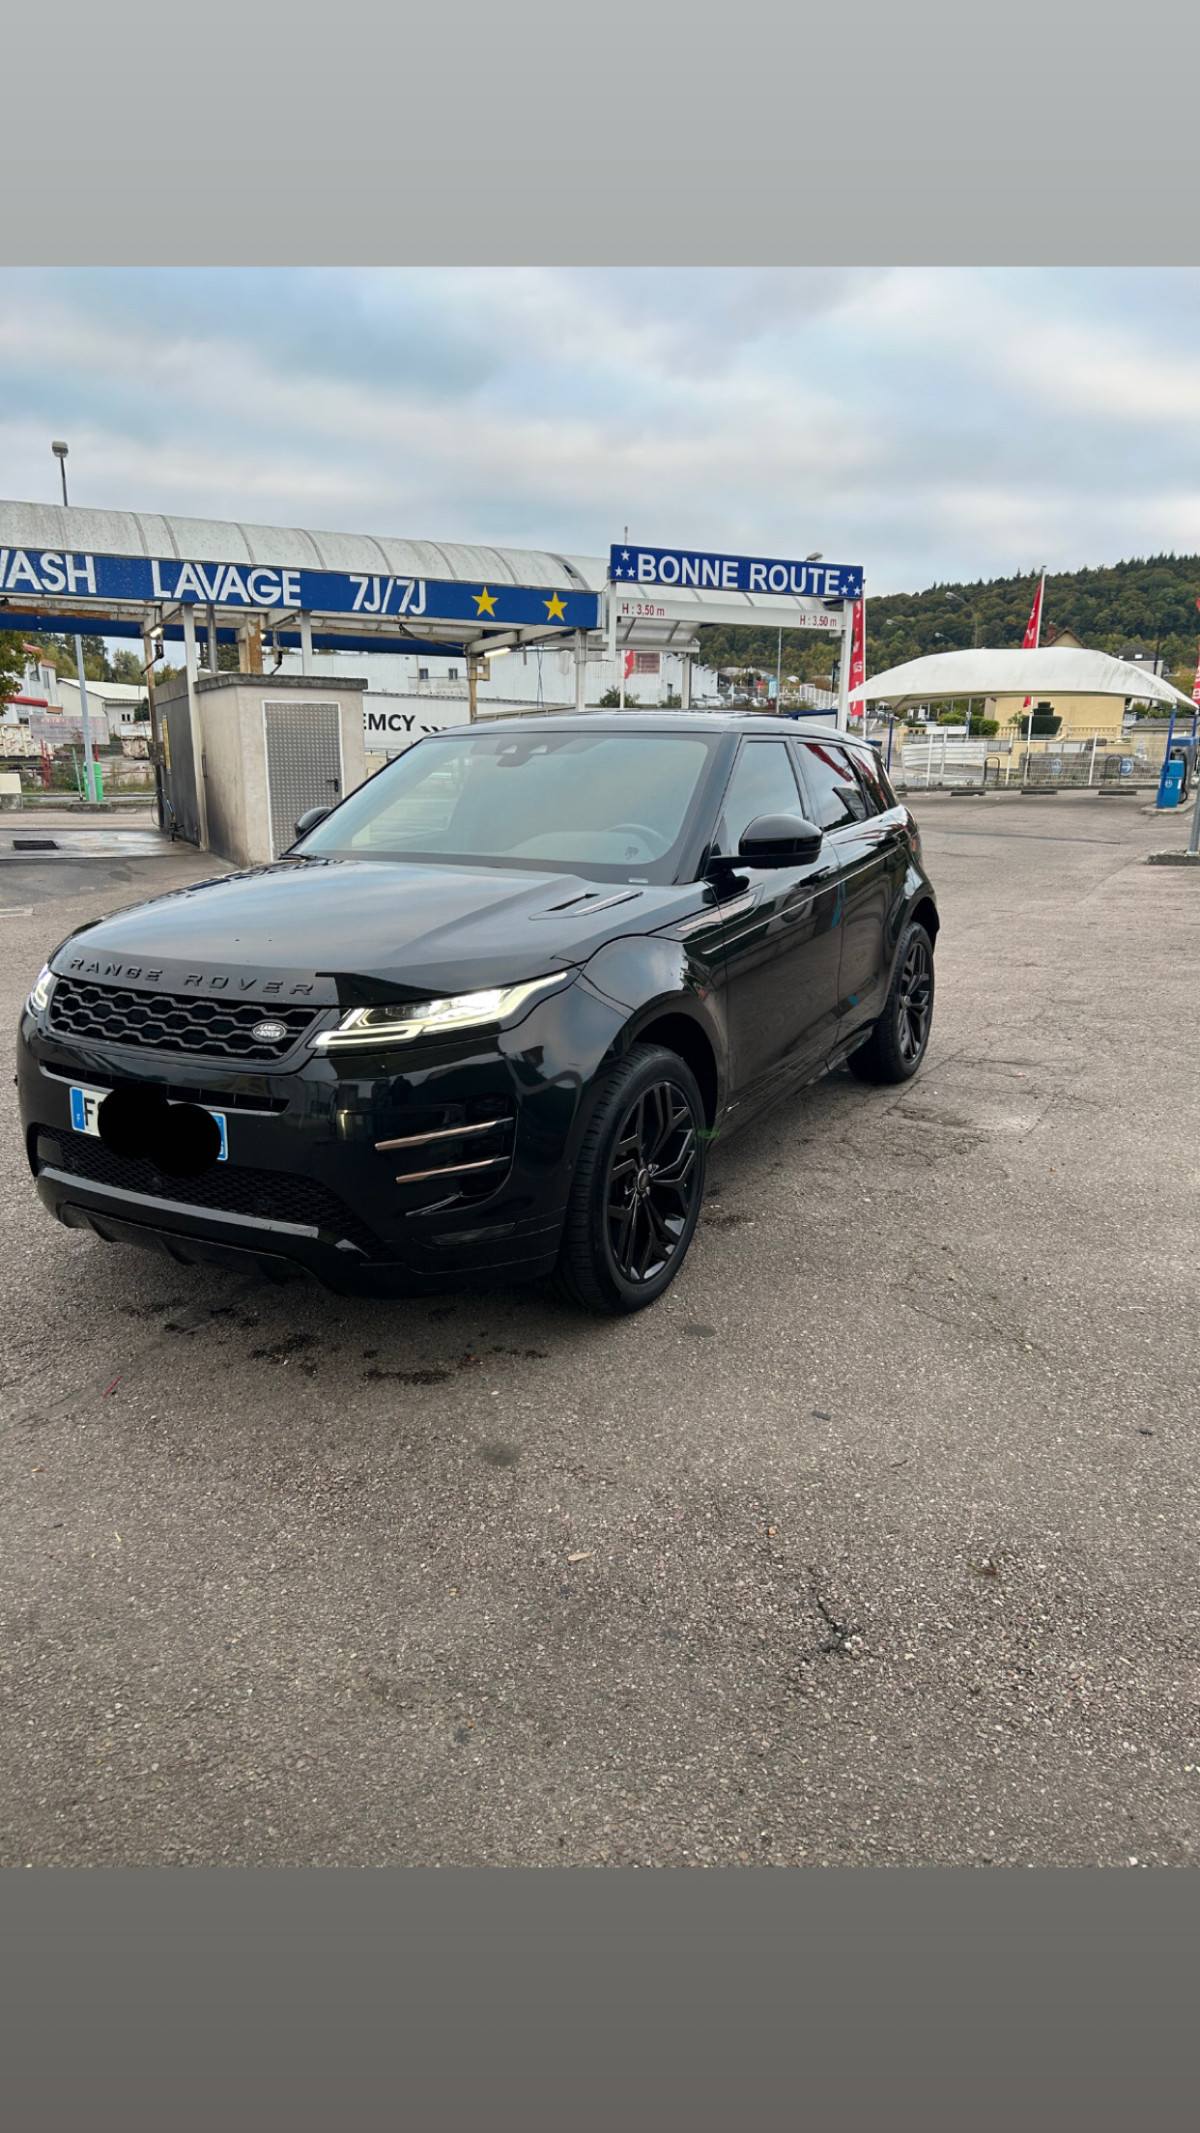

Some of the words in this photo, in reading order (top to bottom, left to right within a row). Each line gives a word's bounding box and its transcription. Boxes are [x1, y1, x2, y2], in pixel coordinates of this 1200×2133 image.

[0, 549, 97, 594] ASH
[151, 559, 302, 608] LAVAGE
[349, 574, 428, 615] 7J/7J
[637, 553, 739, 588] BONNE
[750, 562, 841, 596] ROUTE
[622, 603, 629, 615] H
[657, 607, 665, 616] m
[800, 614, 806, 625] H
[830, 618, 837, 627] m
[70, 957, 164, 982] RANGE
[184, 972, 314, 996] ROVER
